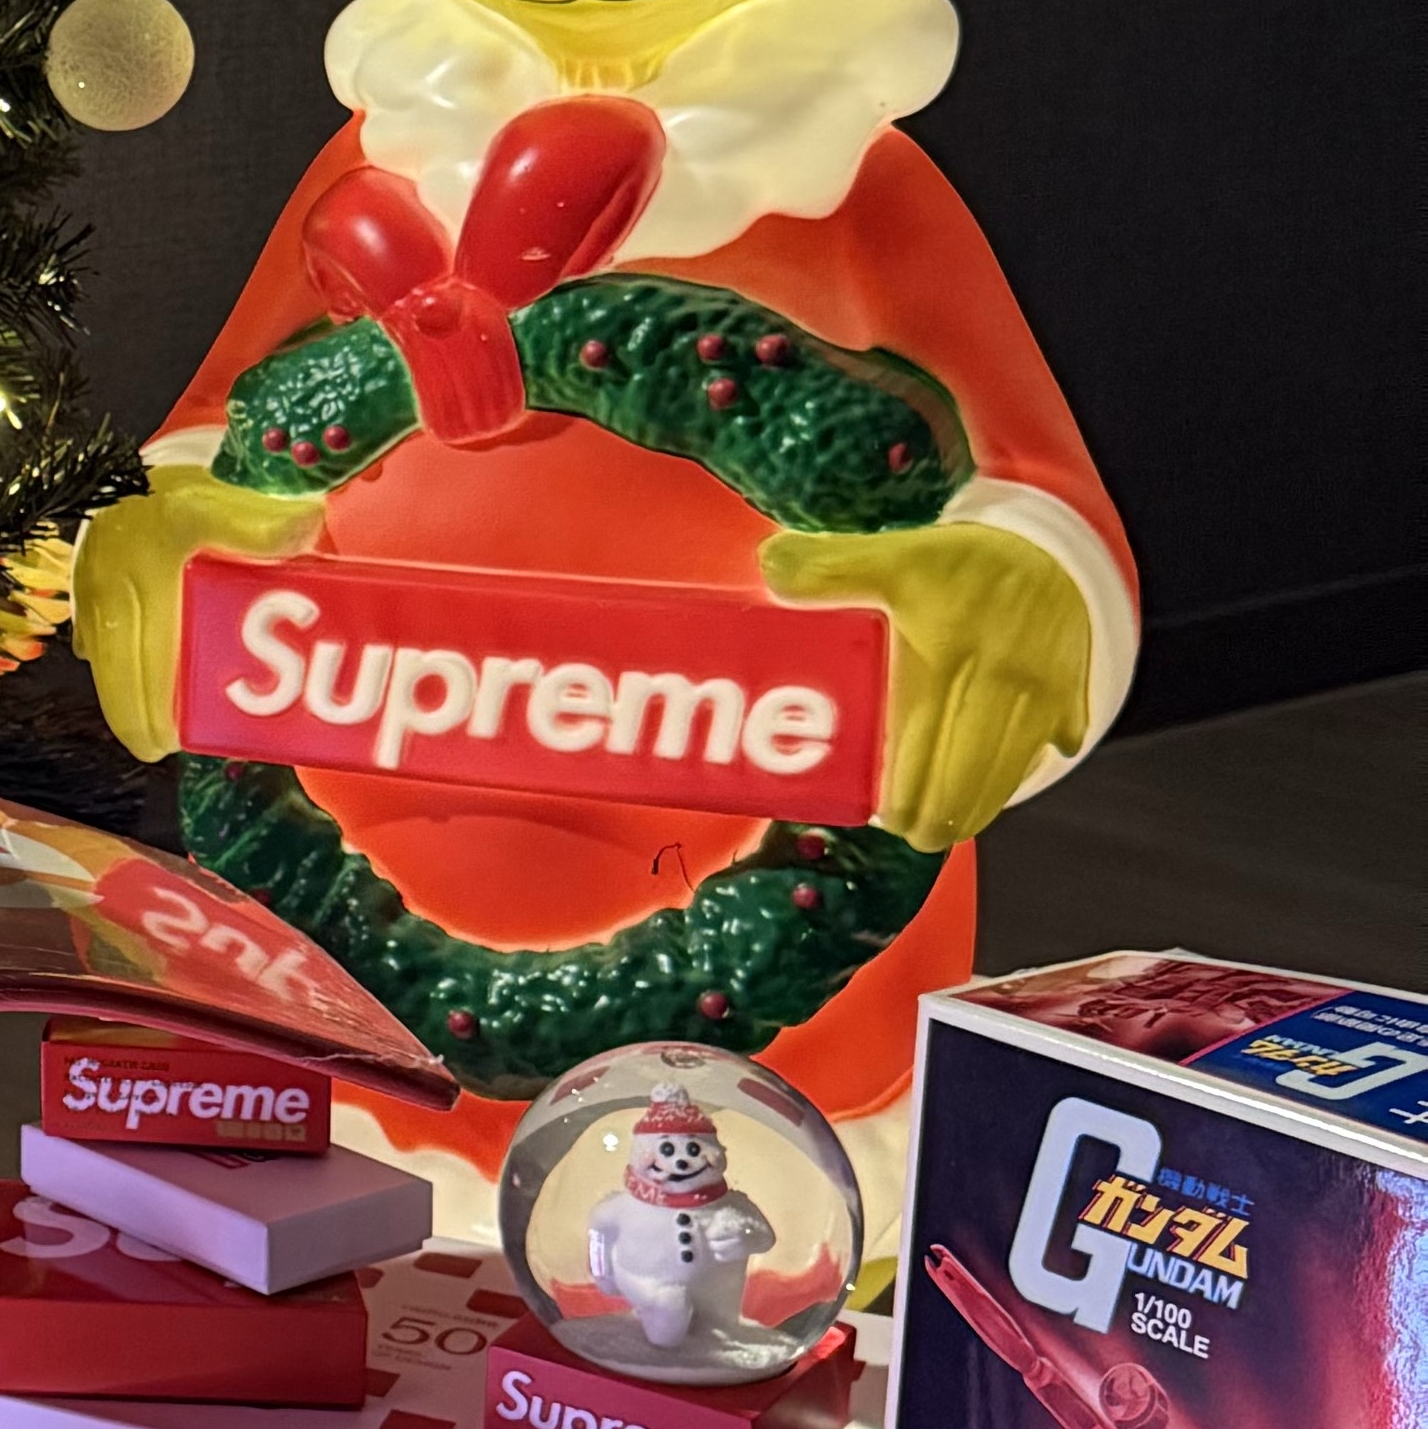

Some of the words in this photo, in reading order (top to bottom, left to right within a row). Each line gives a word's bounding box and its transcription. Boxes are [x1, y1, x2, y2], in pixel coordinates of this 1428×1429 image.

[225, 589, 836, 773] Supreme
[63, 1058, 309, 1129] Supreme
[1078, 1174, 1249, 1279] ガンダム
[382, 1316, 487, 1355] 50
[1131, 1312, 1210, 1359] SCALE
[1134, 1292, 1193, 1329] 1/100
